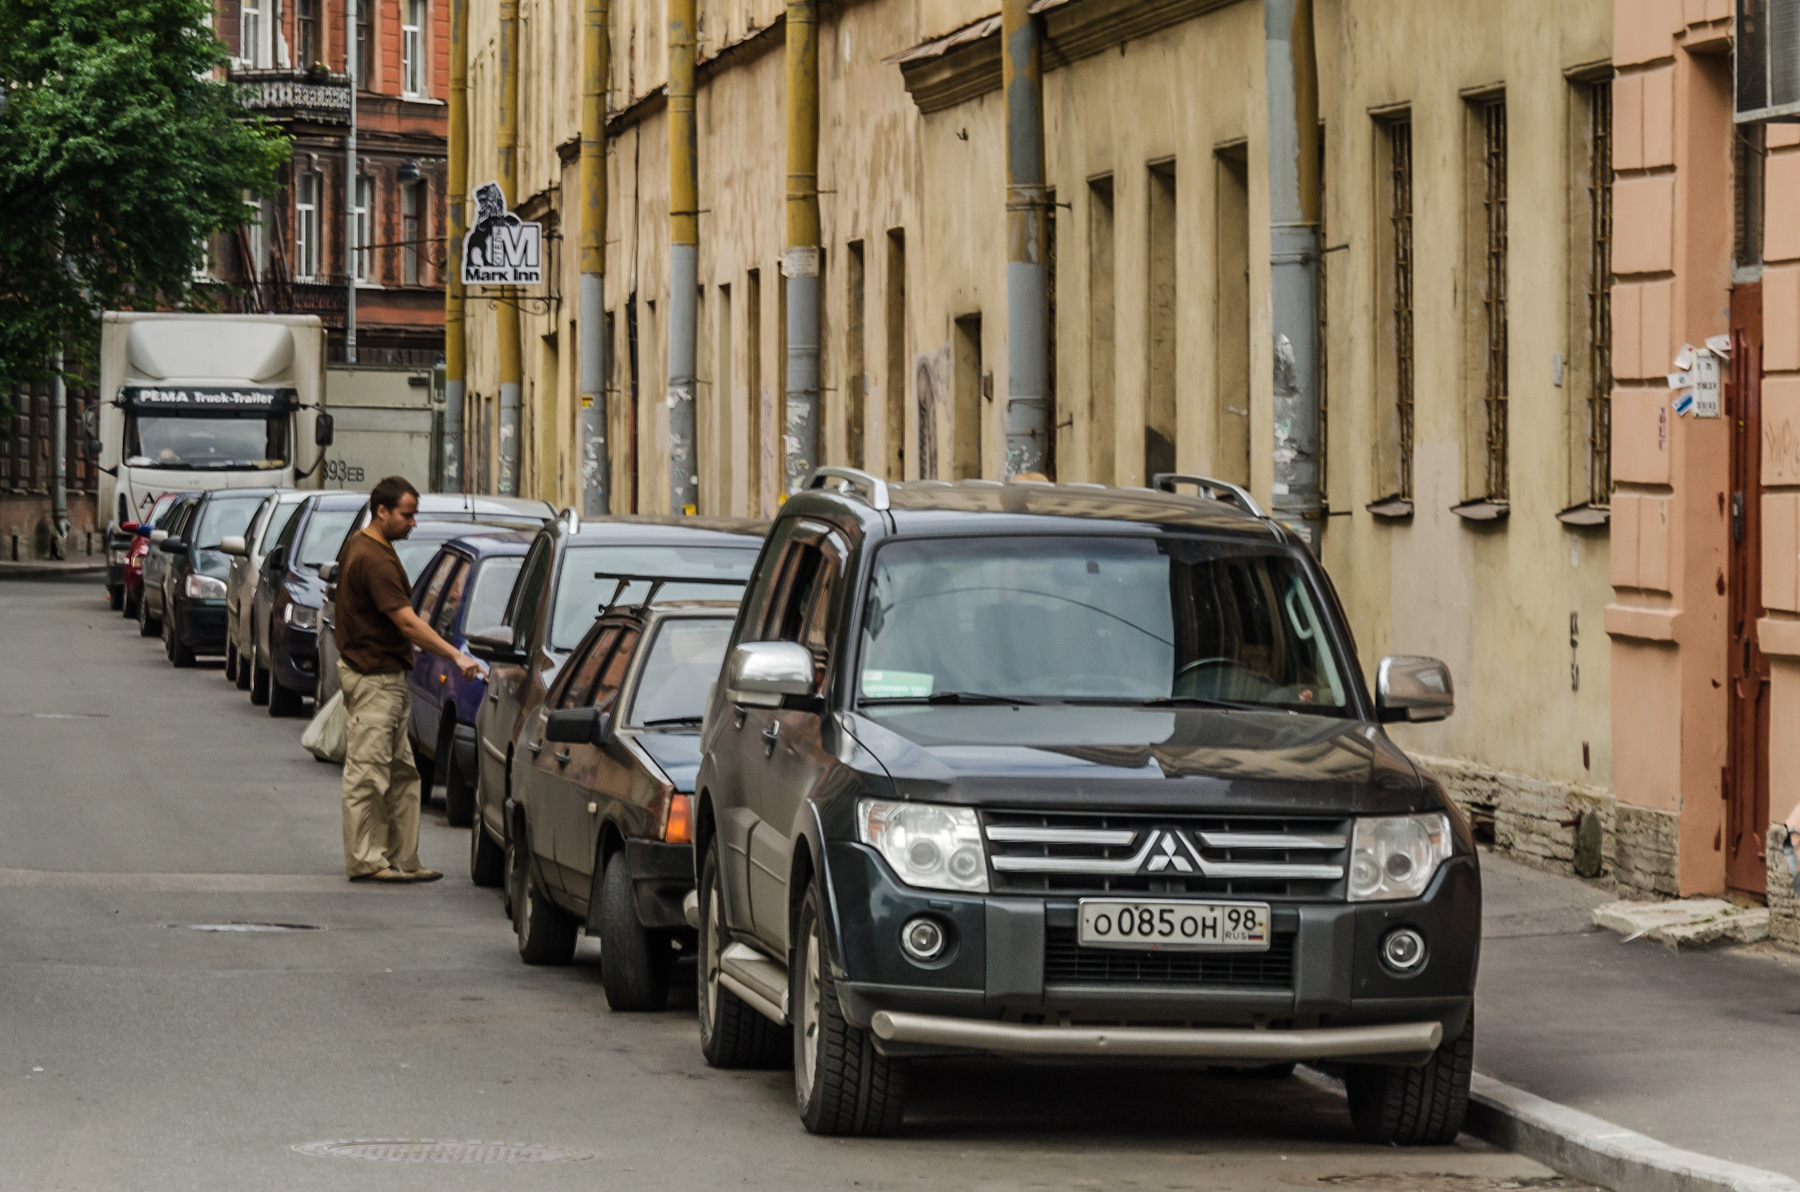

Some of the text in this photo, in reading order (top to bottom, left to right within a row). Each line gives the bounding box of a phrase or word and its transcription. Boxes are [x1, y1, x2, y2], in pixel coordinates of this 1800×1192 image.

[514, 269, 539, 281] Inn
[140, 390, 274, 404] PEMA Truck-Trailer
[1227, 908, 1257, 931] 98
[1225, 932, 1248, 940] RUS
